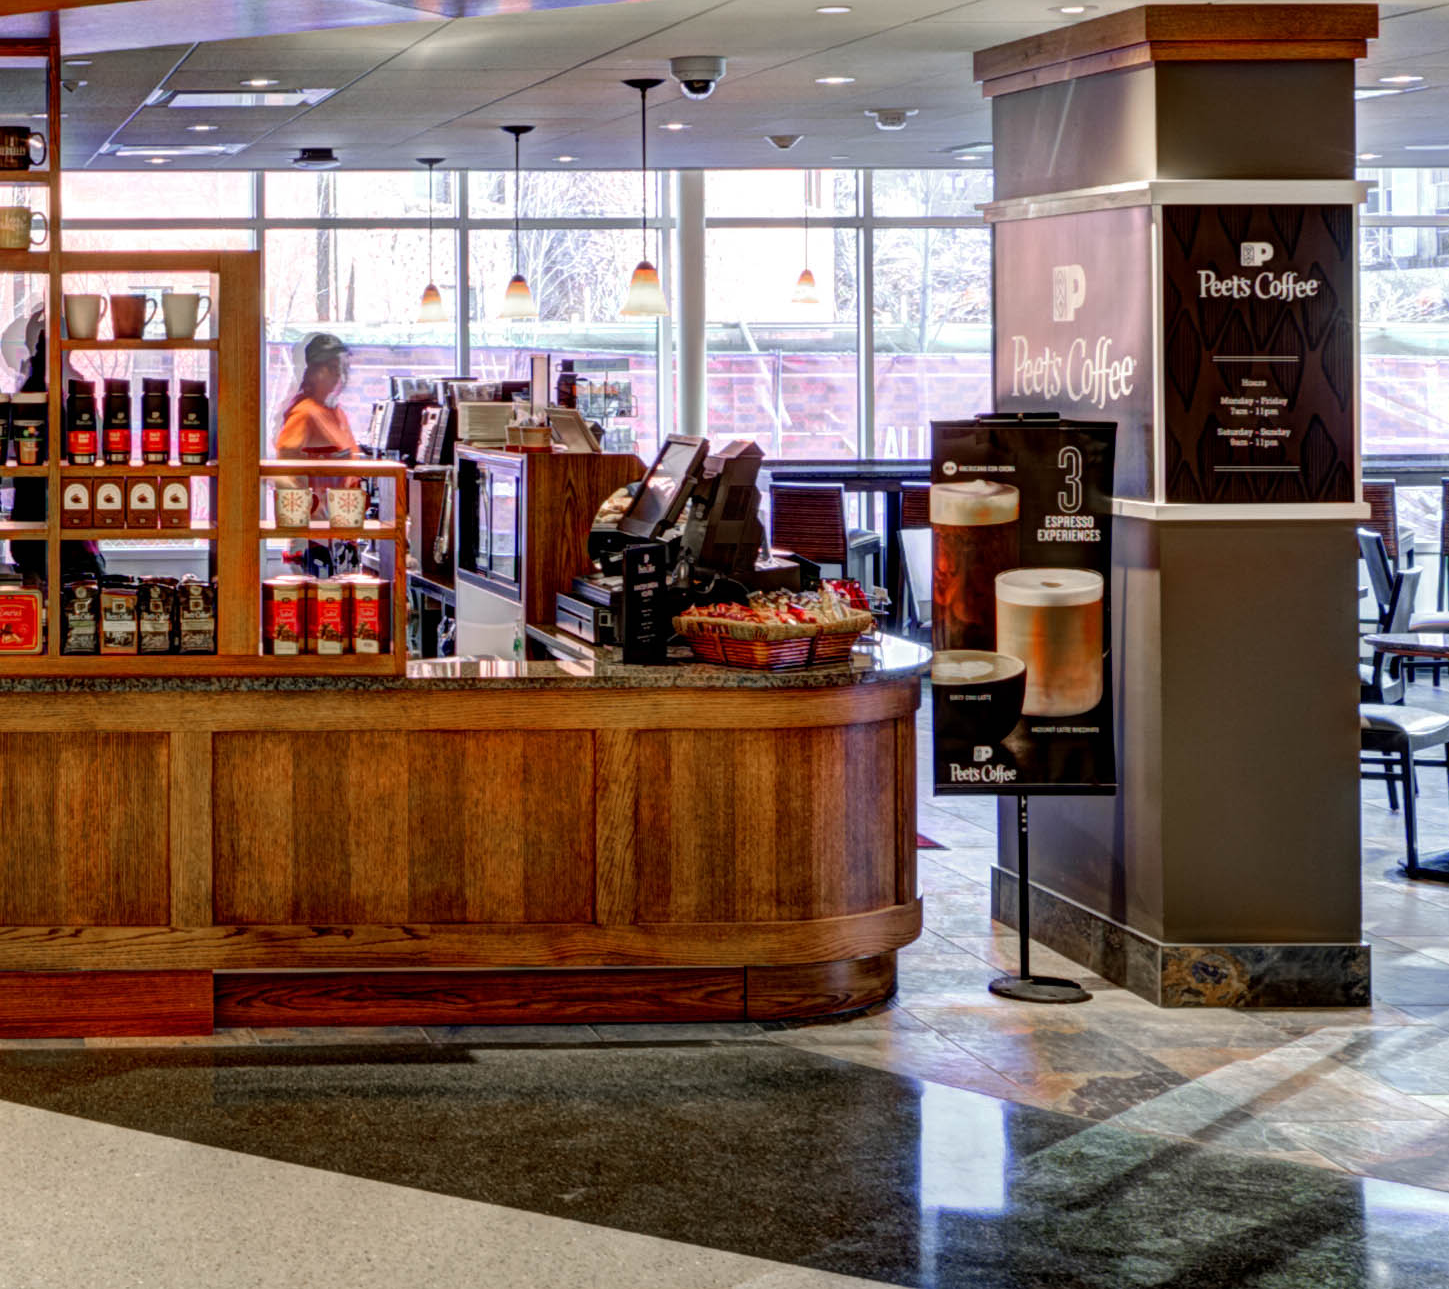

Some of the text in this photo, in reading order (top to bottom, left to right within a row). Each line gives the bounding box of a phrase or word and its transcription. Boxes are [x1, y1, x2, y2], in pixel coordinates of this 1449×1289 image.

[1197, 270, 1318, 302] Peet's Coffee
[1011, 335, 1134, 409] Peet's Coffee
[1058, 446, 1082, 513] 3
[1045, 515, 1094, 528] ESPRESSO
[1037, 529, 1101, 542] EXPERIENCES
[950, 763, 1016, 783] Peet's Coffee
